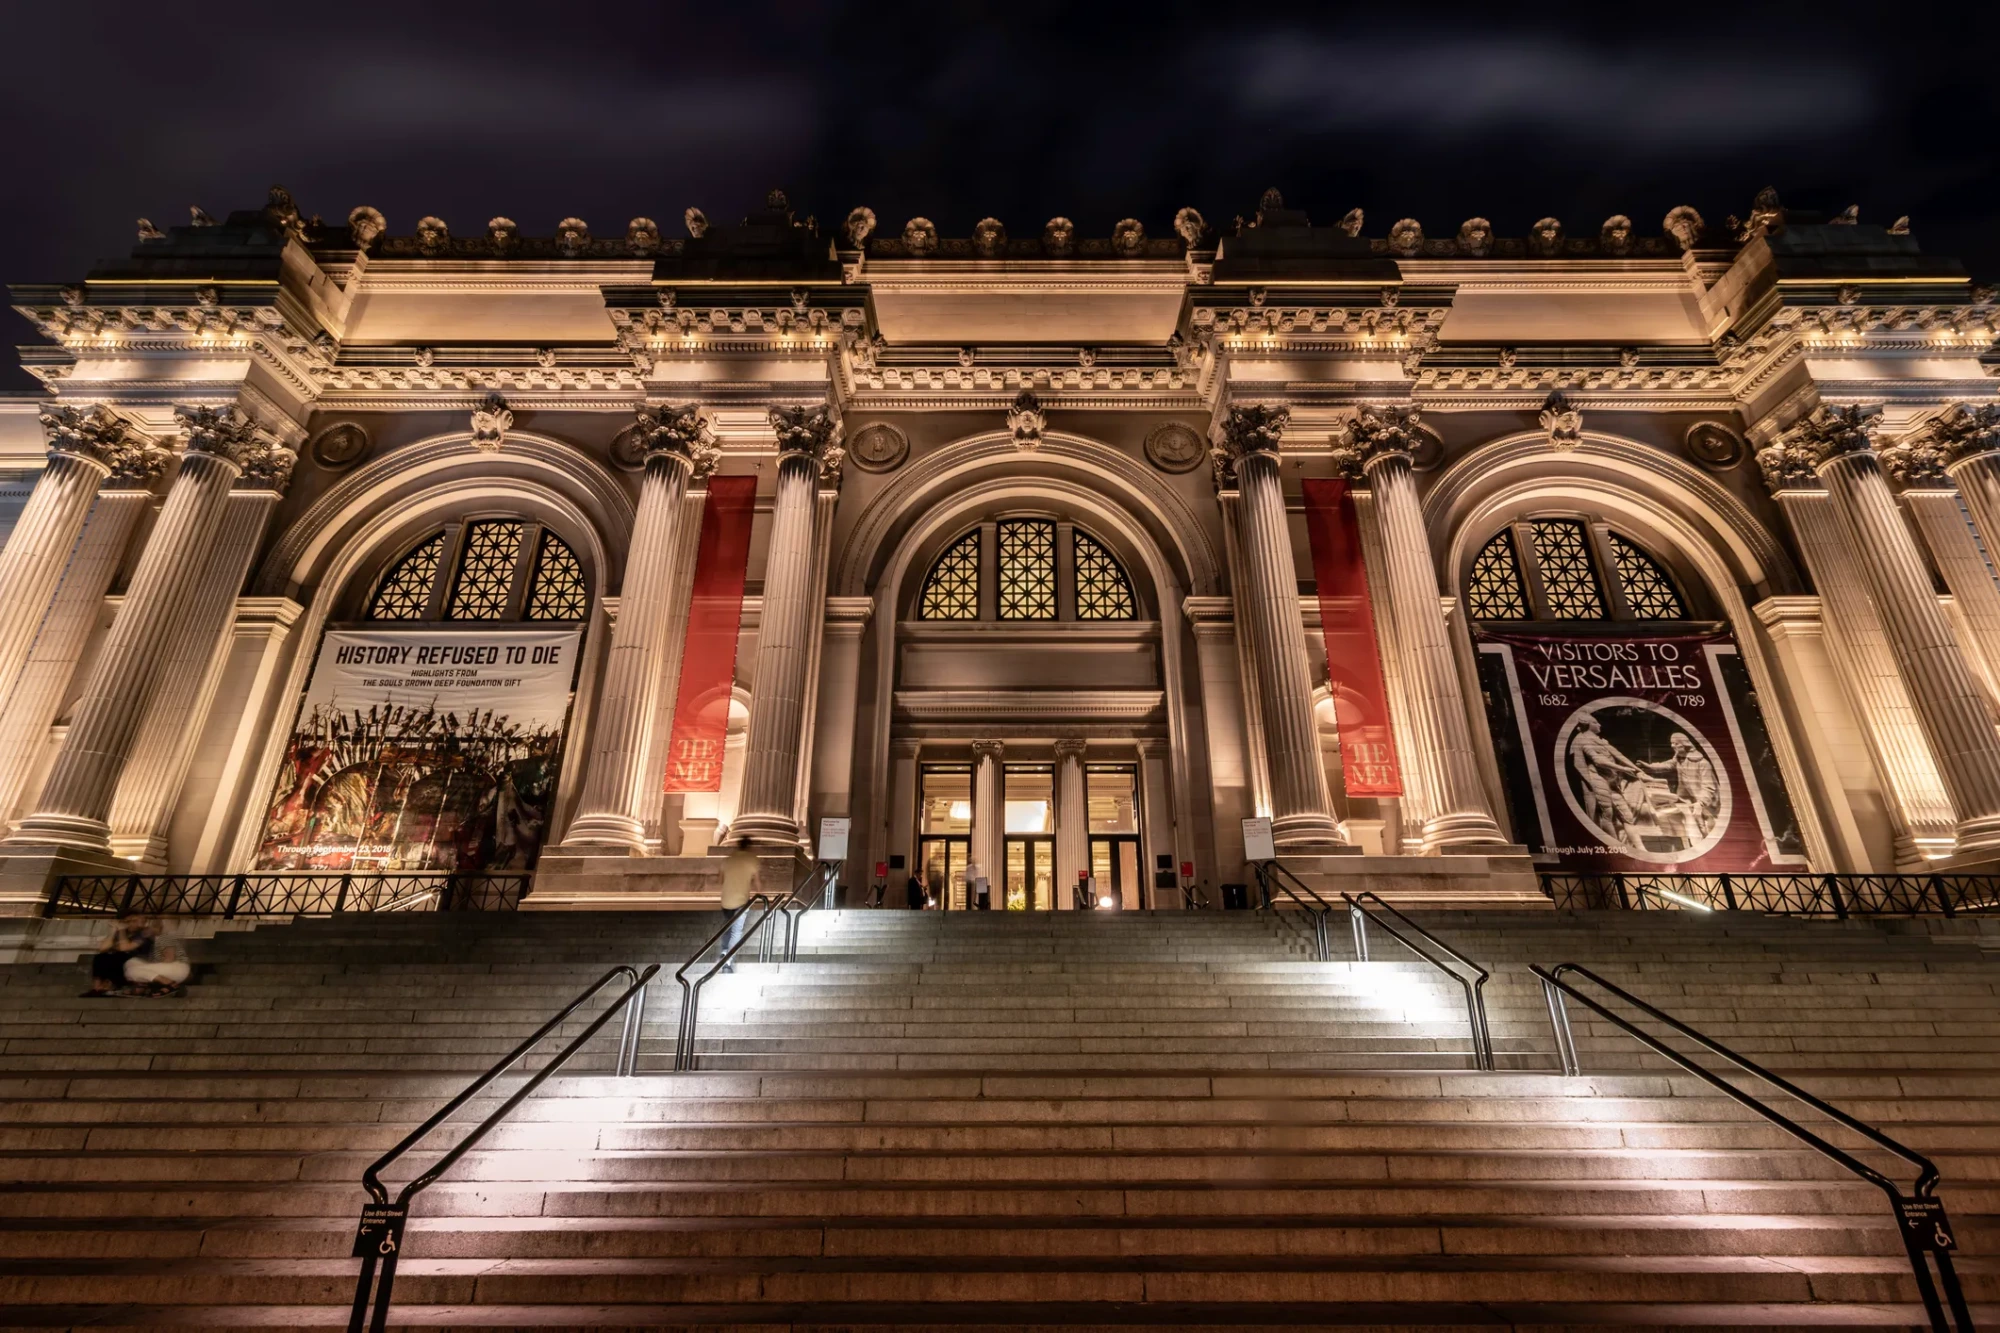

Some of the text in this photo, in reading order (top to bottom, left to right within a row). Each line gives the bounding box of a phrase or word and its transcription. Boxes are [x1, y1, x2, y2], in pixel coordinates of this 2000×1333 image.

[336, 646, 561, 664] HISTORY REFUSED TO DIE
[1538, 643, 1678, 661] VISITORS TO
[411, 669, 477, 677] HIGHLIGHTS FROM
[1529, 665, 1701, 689] VERSAILLES
[362, 679, 522, 687] THE SOULS GROWN DEEP FOUNDATION GIFT
[1538, 694, 1569, 706] 1682
[1676, 694, 1705, 707] 1789
[672, 761, 717, 782] MET
[1350, 764, 1393, 785] MET
[277, 845, 391, 855] Through September 23, 2018
[1540, 845, 1627, 855] Through July 29, 2018
